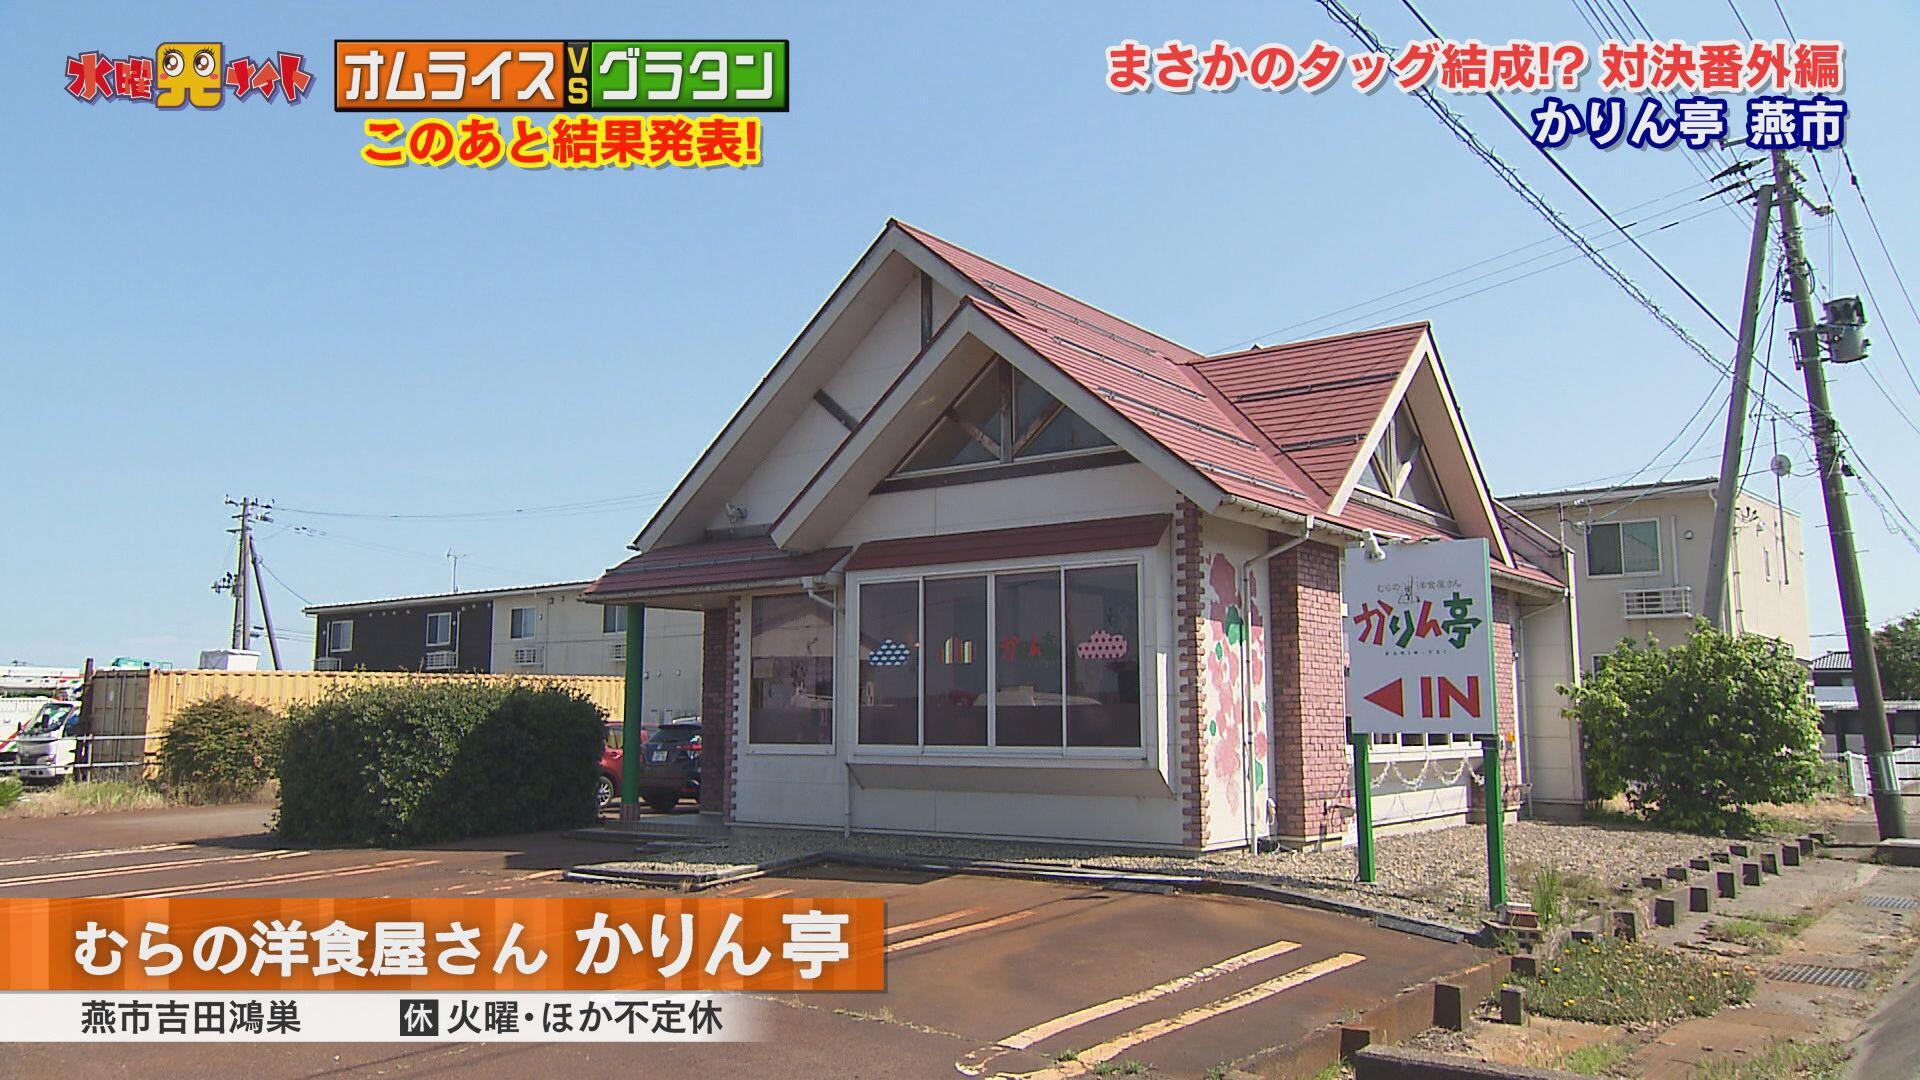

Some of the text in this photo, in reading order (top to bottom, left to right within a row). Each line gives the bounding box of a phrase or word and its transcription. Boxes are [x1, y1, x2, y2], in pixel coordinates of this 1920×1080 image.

[1353, 592, 1483, 650] かりん亭
[1420, 675, 1481, 719] IN
